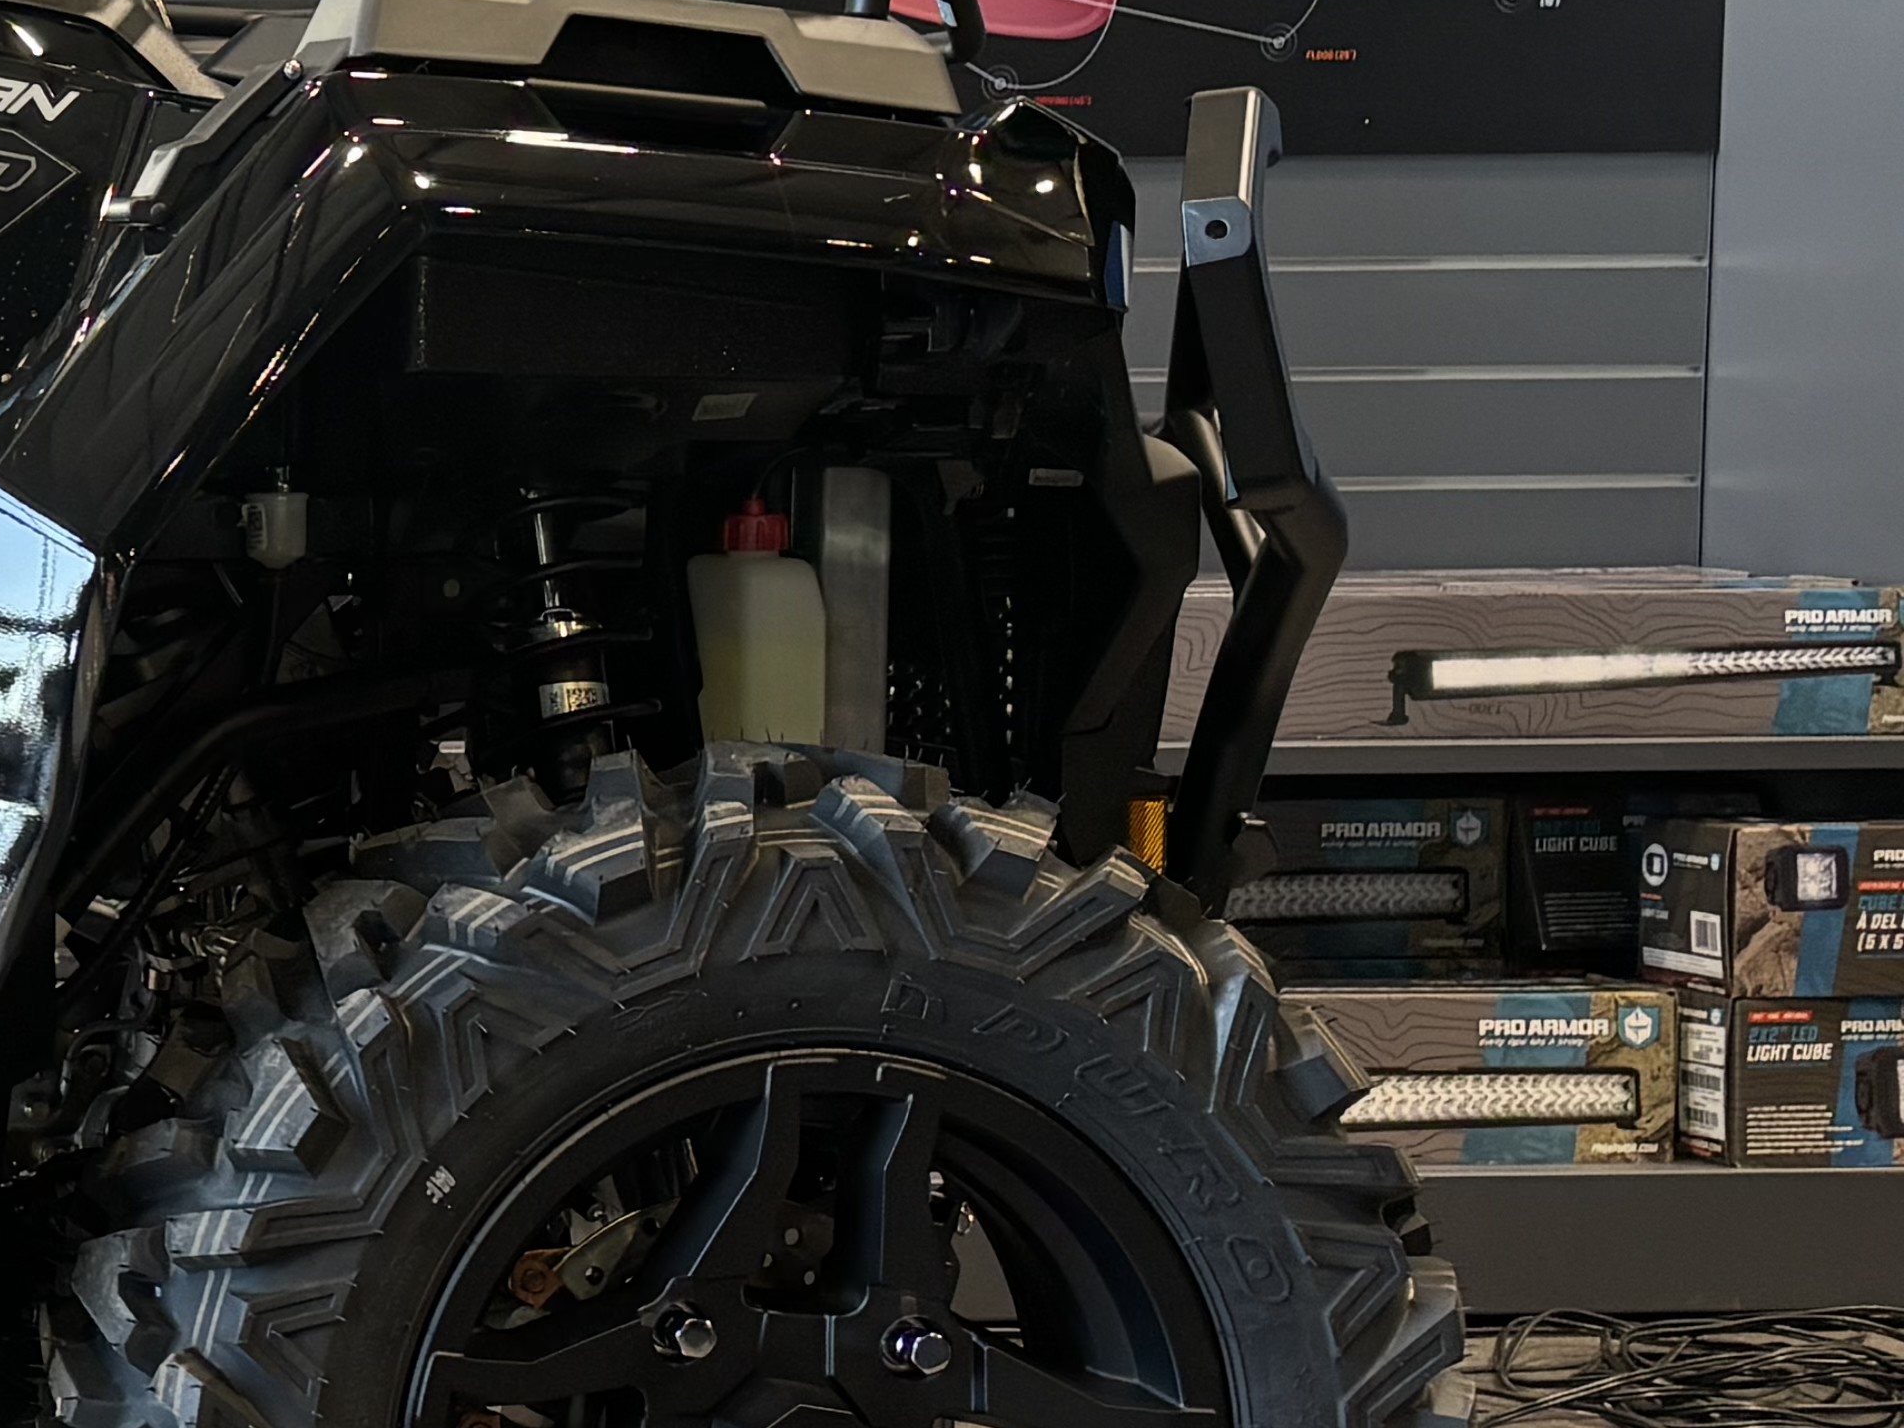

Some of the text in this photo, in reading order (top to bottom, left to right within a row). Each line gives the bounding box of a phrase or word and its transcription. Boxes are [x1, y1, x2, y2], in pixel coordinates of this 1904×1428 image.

[1784, 608, 1892, 624] PRO ARMOR
[1321, 821, 1441, 838] PRO ARMOR
[1535, 836, 1618, 852] LIGHT CUBE
[1858, 895, 1896, 910] CUBE
[1873, 913, 1898, 929] DEL
[1479, 1019, 1610, 1036] PRO ARMOR
[1792, 1026, 1820, 1042] LED
[1841, 1020, 1875, 1033] PRO
[1746, 1043, 1834, 1062] LIGHT CUBE
